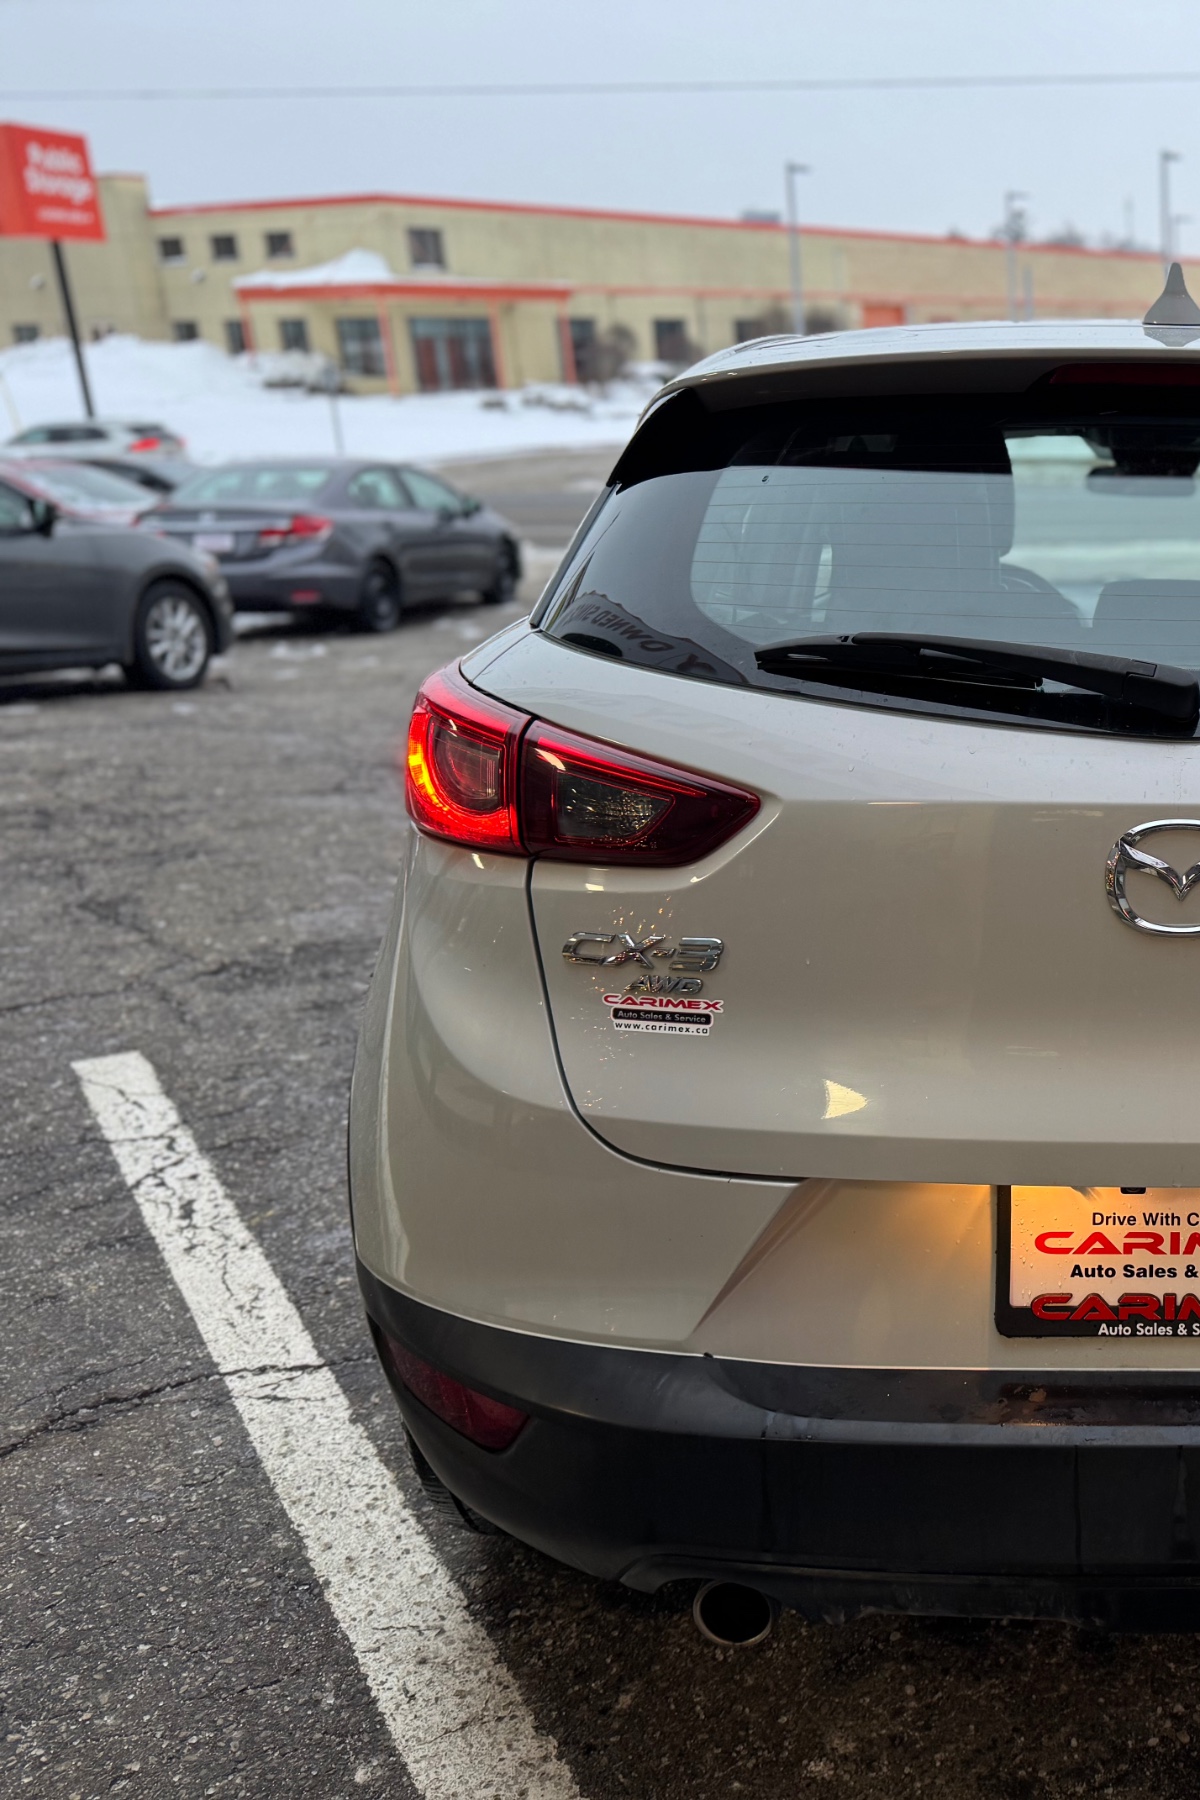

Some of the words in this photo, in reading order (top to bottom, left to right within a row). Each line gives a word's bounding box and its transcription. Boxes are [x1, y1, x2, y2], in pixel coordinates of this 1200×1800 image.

[562, 931, 724, 972] CX-3
[623, 974, 704, 995] AWD
[603, 994, 722, 1011] CARIMEX
[617, 1010, 638, 1019] Auto
[640, 1011, 662, 1020] Sales
[674, 1014, 706, 1023] Service
[615, 1022, 708, 1035] www.carimex.ca
[1092, 1212, 1137, 1226] Drive
[1142, 1212, 1181, 1226] With
[1070, 1264, 1116, 1278] Auto
[1122, 1264, 1177, 1278] Sales
[1184, 1264, 1199, 1278] &
[1098, 1323, 1132, 1336] Auto
[1136, 1323, 1173, 1336] Sales
[1177, 1324, 1188, 1336] &
